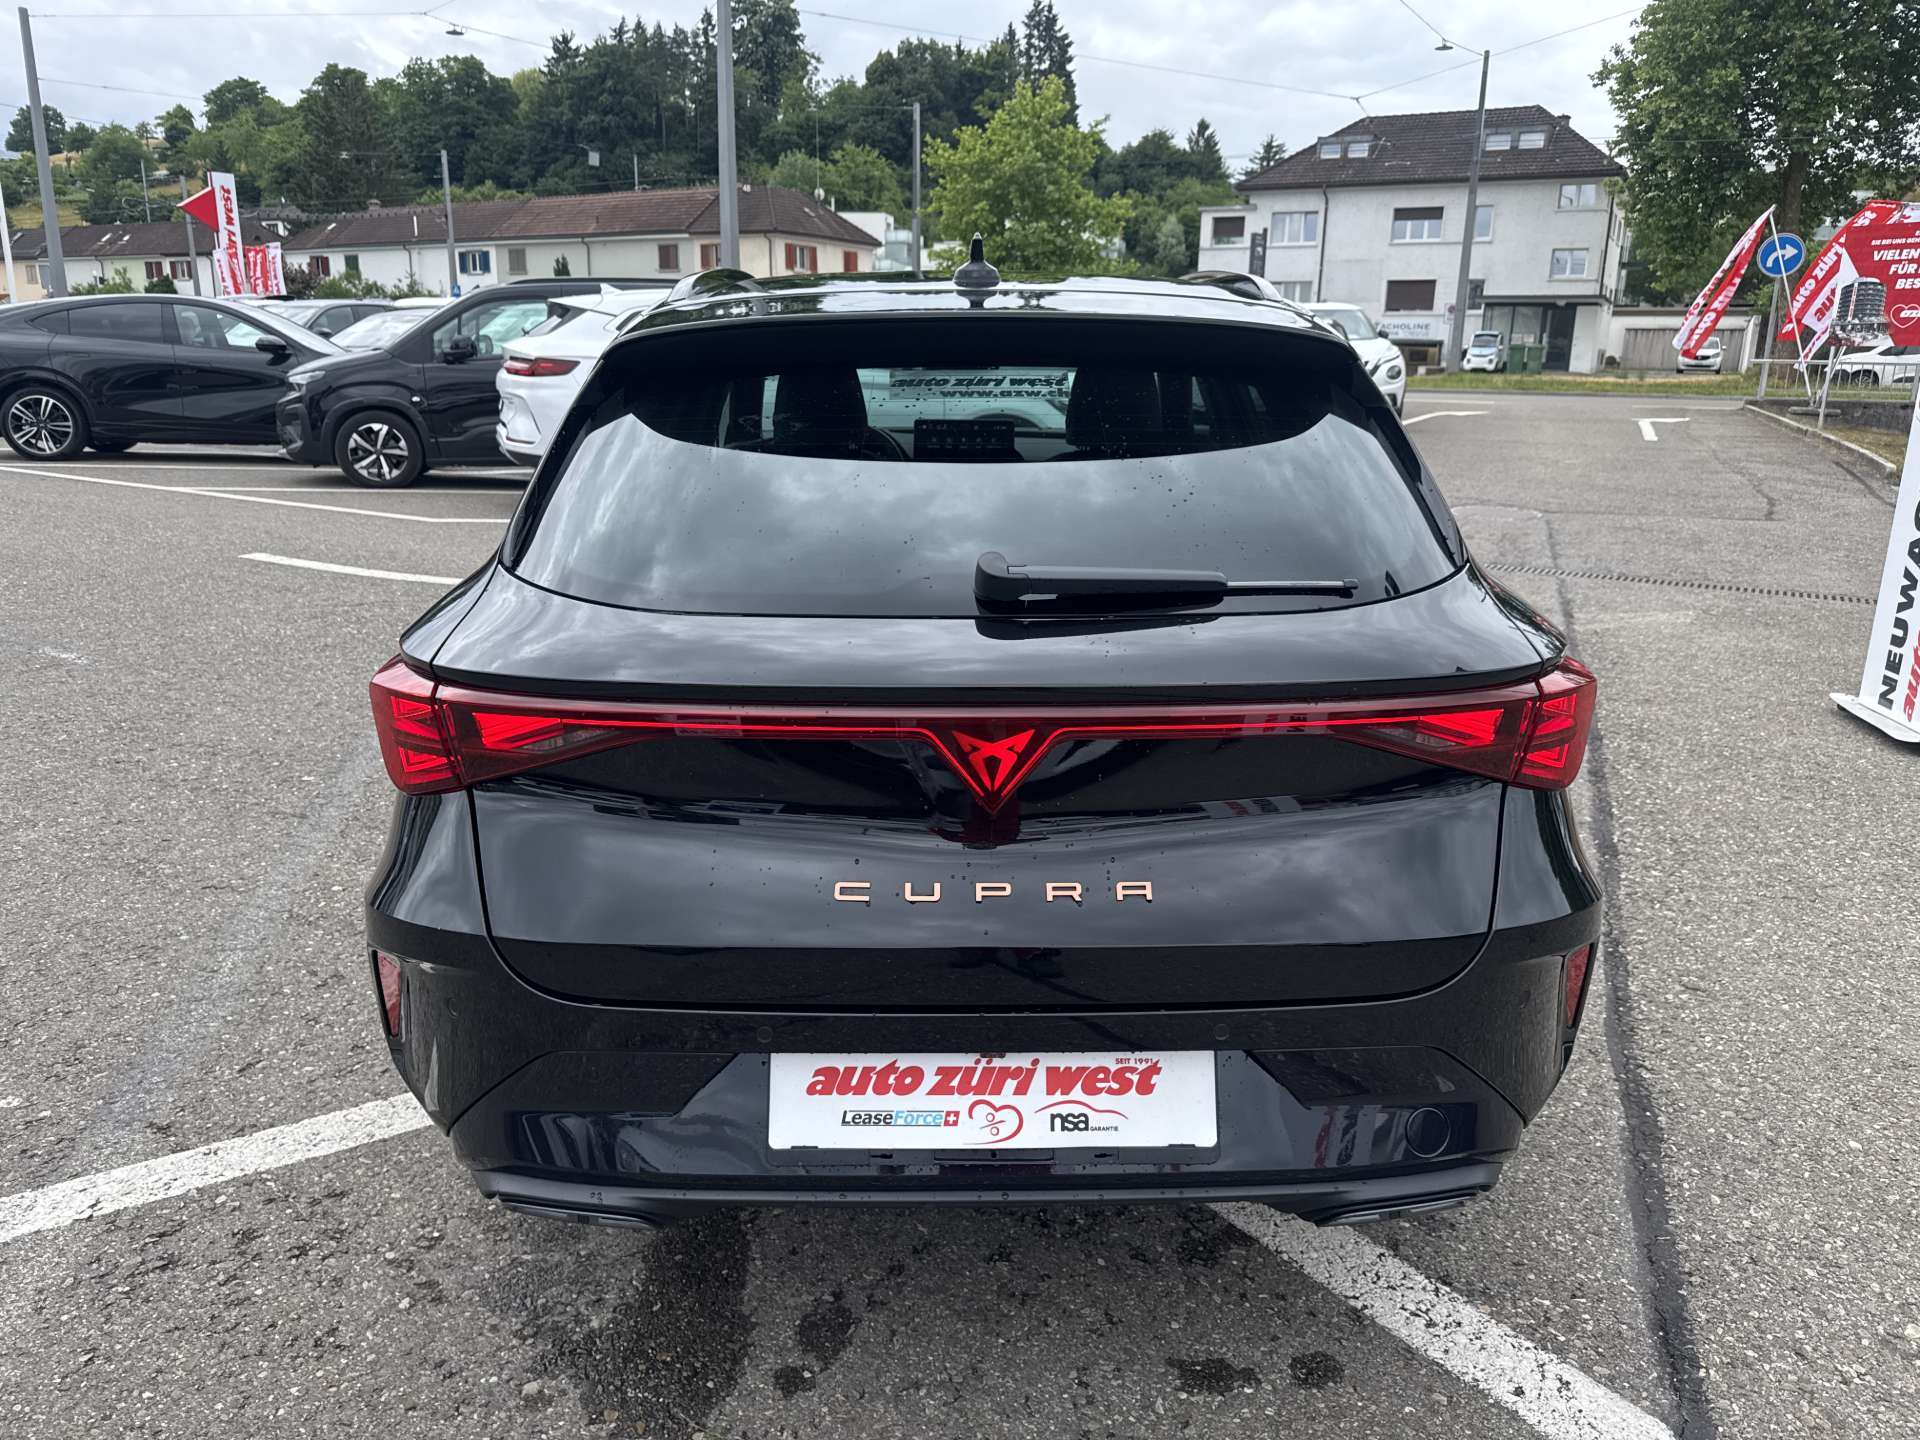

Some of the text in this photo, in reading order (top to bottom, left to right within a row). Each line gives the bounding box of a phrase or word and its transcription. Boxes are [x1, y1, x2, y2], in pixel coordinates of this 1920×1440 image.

[1873, 248, 1920, 261] VIELEN
[1889, 261, 1918, 275] FÜR
[1814, 287, 1837, 321] aut
[890, 376, 950, 387] auto
[1009, 375, 1069, 387] west
[1903, 629, 1920, 722] aut
[833, 881, 1153, 902] CUPRA
[1115, 1057, 1153, 1065] SEIT 1991
[806, 1057, 1163, 1096] auto züri west
[841, 1109, 943, 1126] LeaseForce
[1049, 1112, 1089, 1132] nsa
